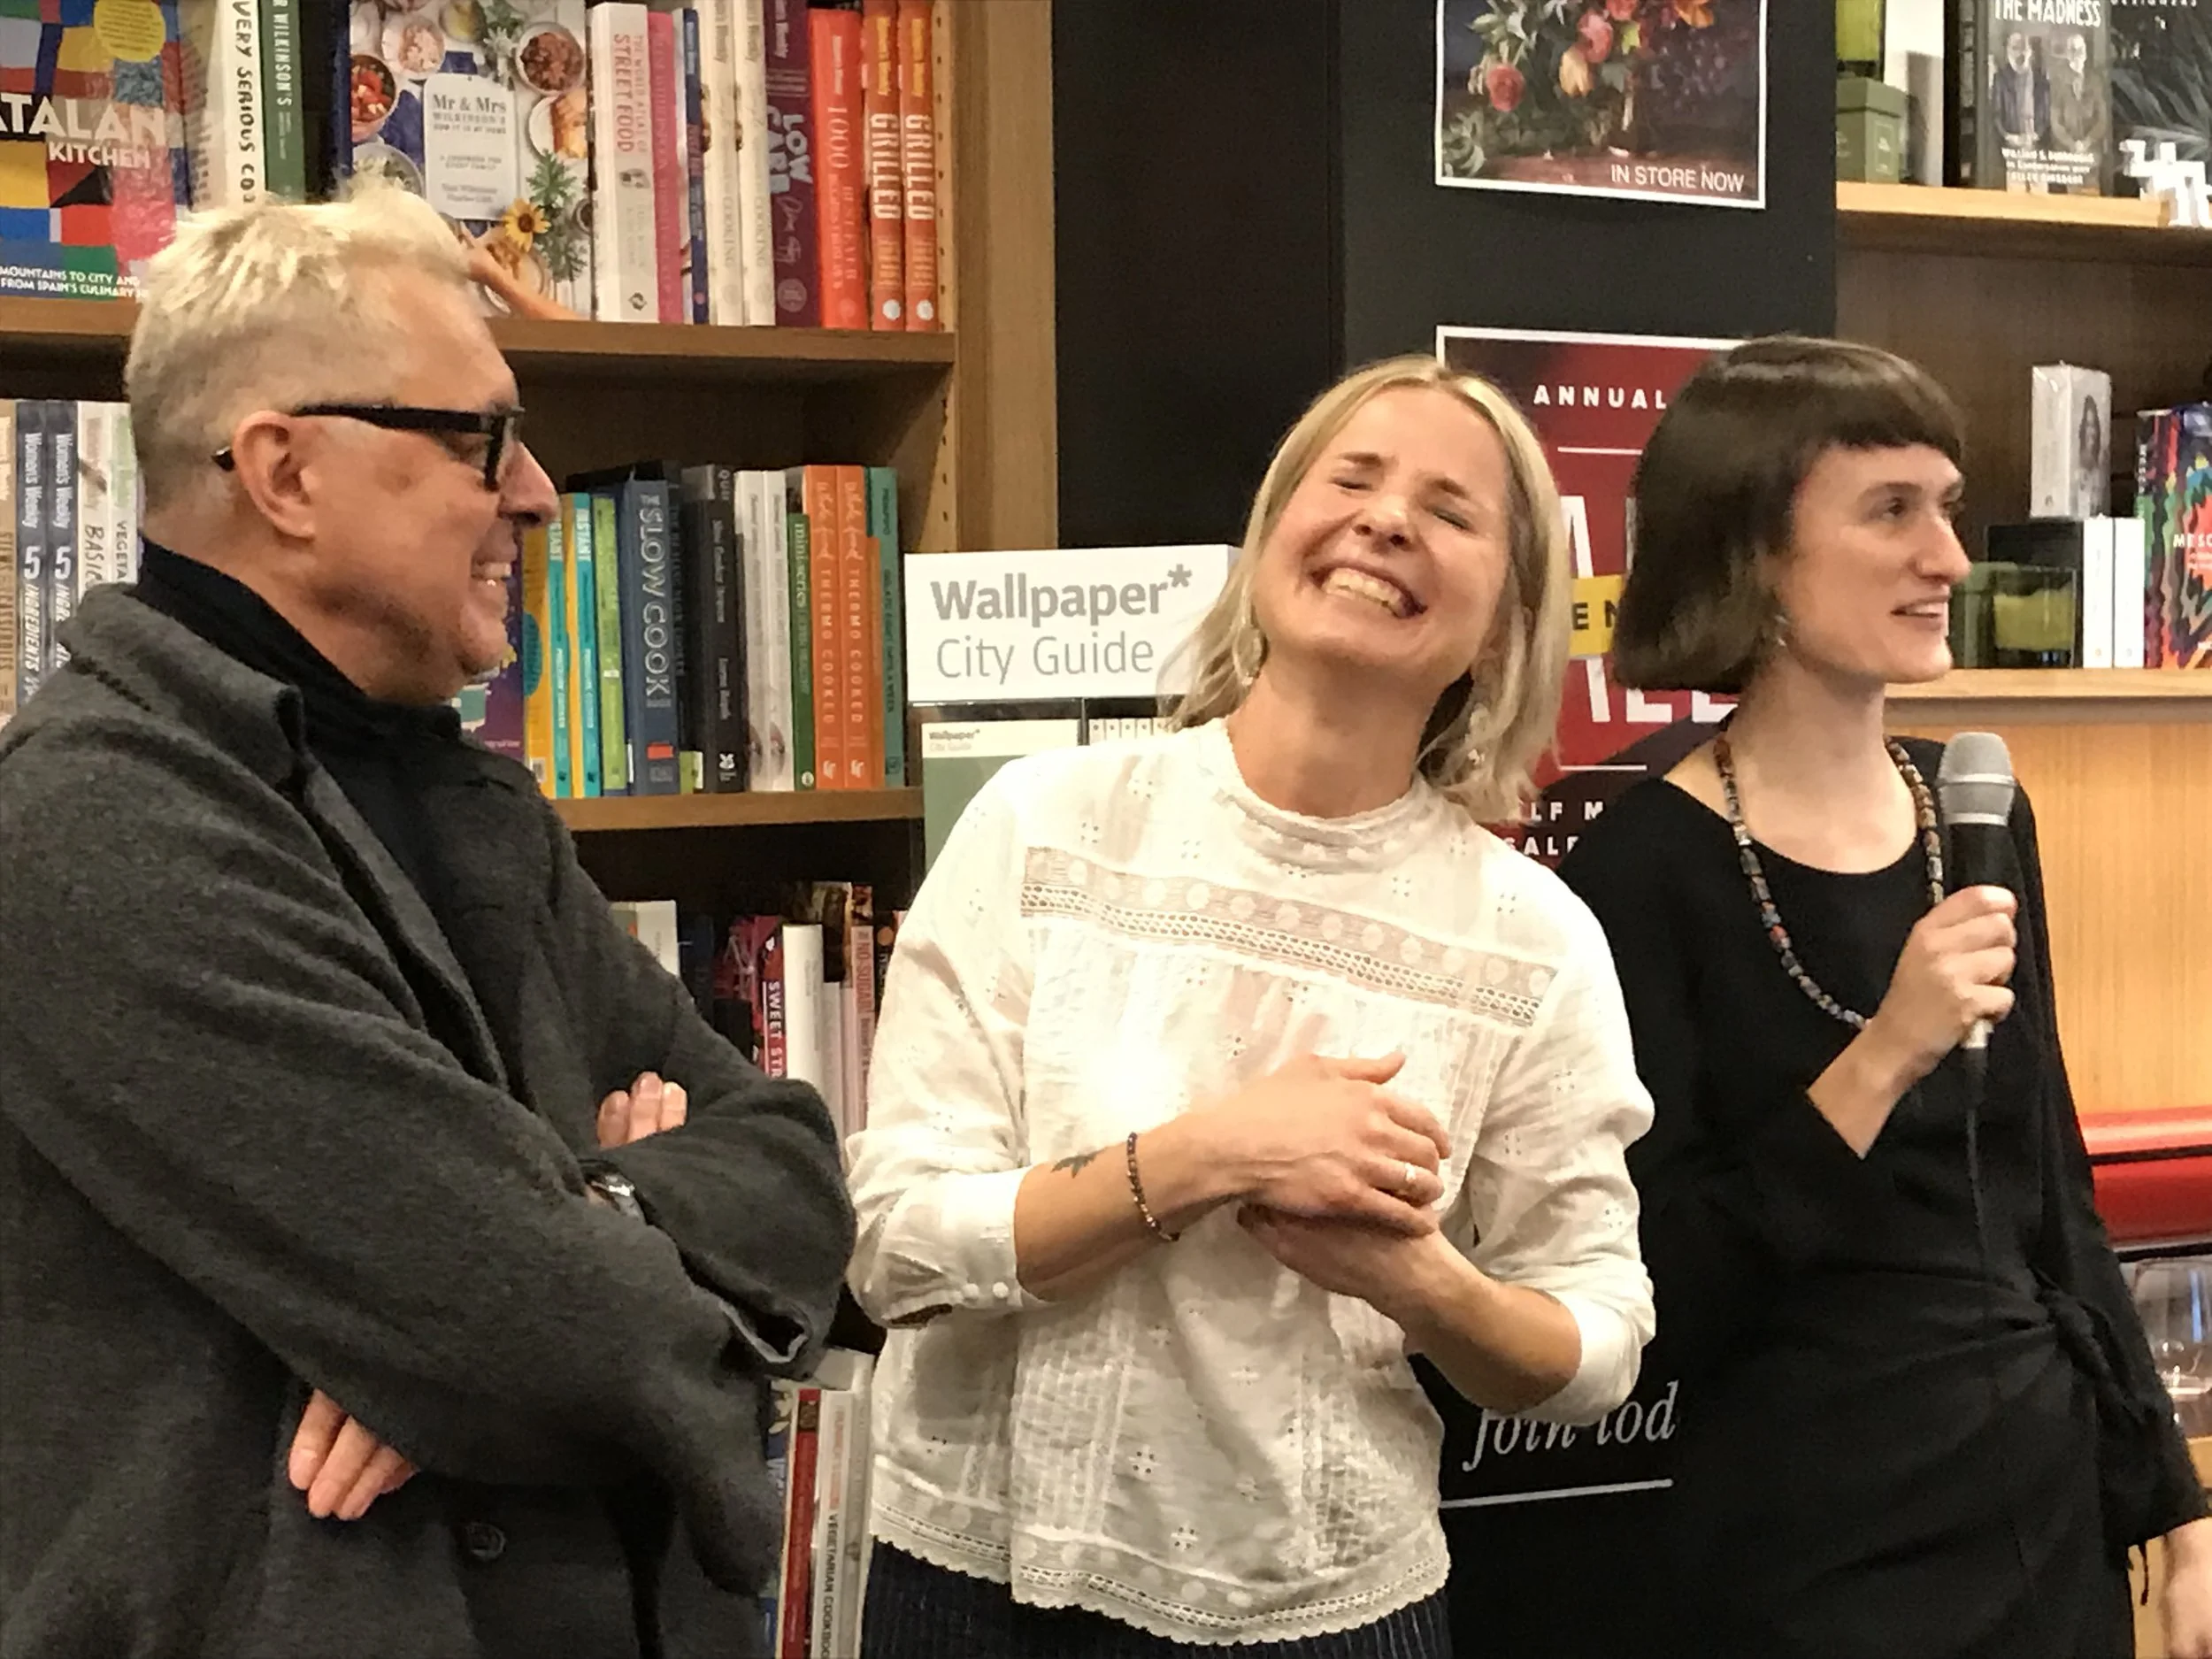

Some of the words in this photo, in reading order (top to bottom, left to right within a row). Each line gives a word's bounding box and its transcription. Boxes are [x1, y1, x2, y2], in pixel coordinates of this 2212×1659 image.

[232, 1, 253, 58] VERY
[1994, 0, 2023, 20] THE
[2027, 2, 2102, 27] MADNESS
[273, 13, 292, 106] WILKINSON'S
[613, 33, 634, 99] STREET
[237, 66, 256, 153] SERIOUS
[433, 94, 456, 110] Mr
[460, 96, 471, 111] &
[476, 96, 506, 113] Mrs
[616, 104, 635, 152] FOOD
[48, 141, 150, 169] KITCHEN
[782, 113, 814, 184] LOW
[827, 106, 849, 168] 1000
[871, 113, 901, 219] GRILLED
[905, 113, 934, 219] GRILLED
[1610, 164, 1631, 184] IN
[1634, 165, 1697, 188] STORE
[1701, 169, 1745, 193] NOW
[0, 265, 67, 281] MOUNTAINS
[69, 271, 86, 282] TO
[88, 273, 113, 287] CITY
[0, 277, 35, 291] FROM
[1533, 384, 1667, 410] ANNUAL
[24, 545, 42, 580] 5
[54, 545, 73, 580] 5
[641, 507, 665, 597] SLOW
[25, 583, 40, 672] INGREDIENTS
[819, 568, 833, 640] THERMO
[849, 568, 863, 640] THERMO
[642, 601, 671, 697] COOK
[936, 634, 1014, 685] City
[1033, 631, 1154, 675] Guide
[821, 649, 836, 724] COOKED
[849, 649, 864, 724] COOKED
[767, 981, 783, 1040] SWEET
[825, 1513, 839, 1593] VEGETARIAN
